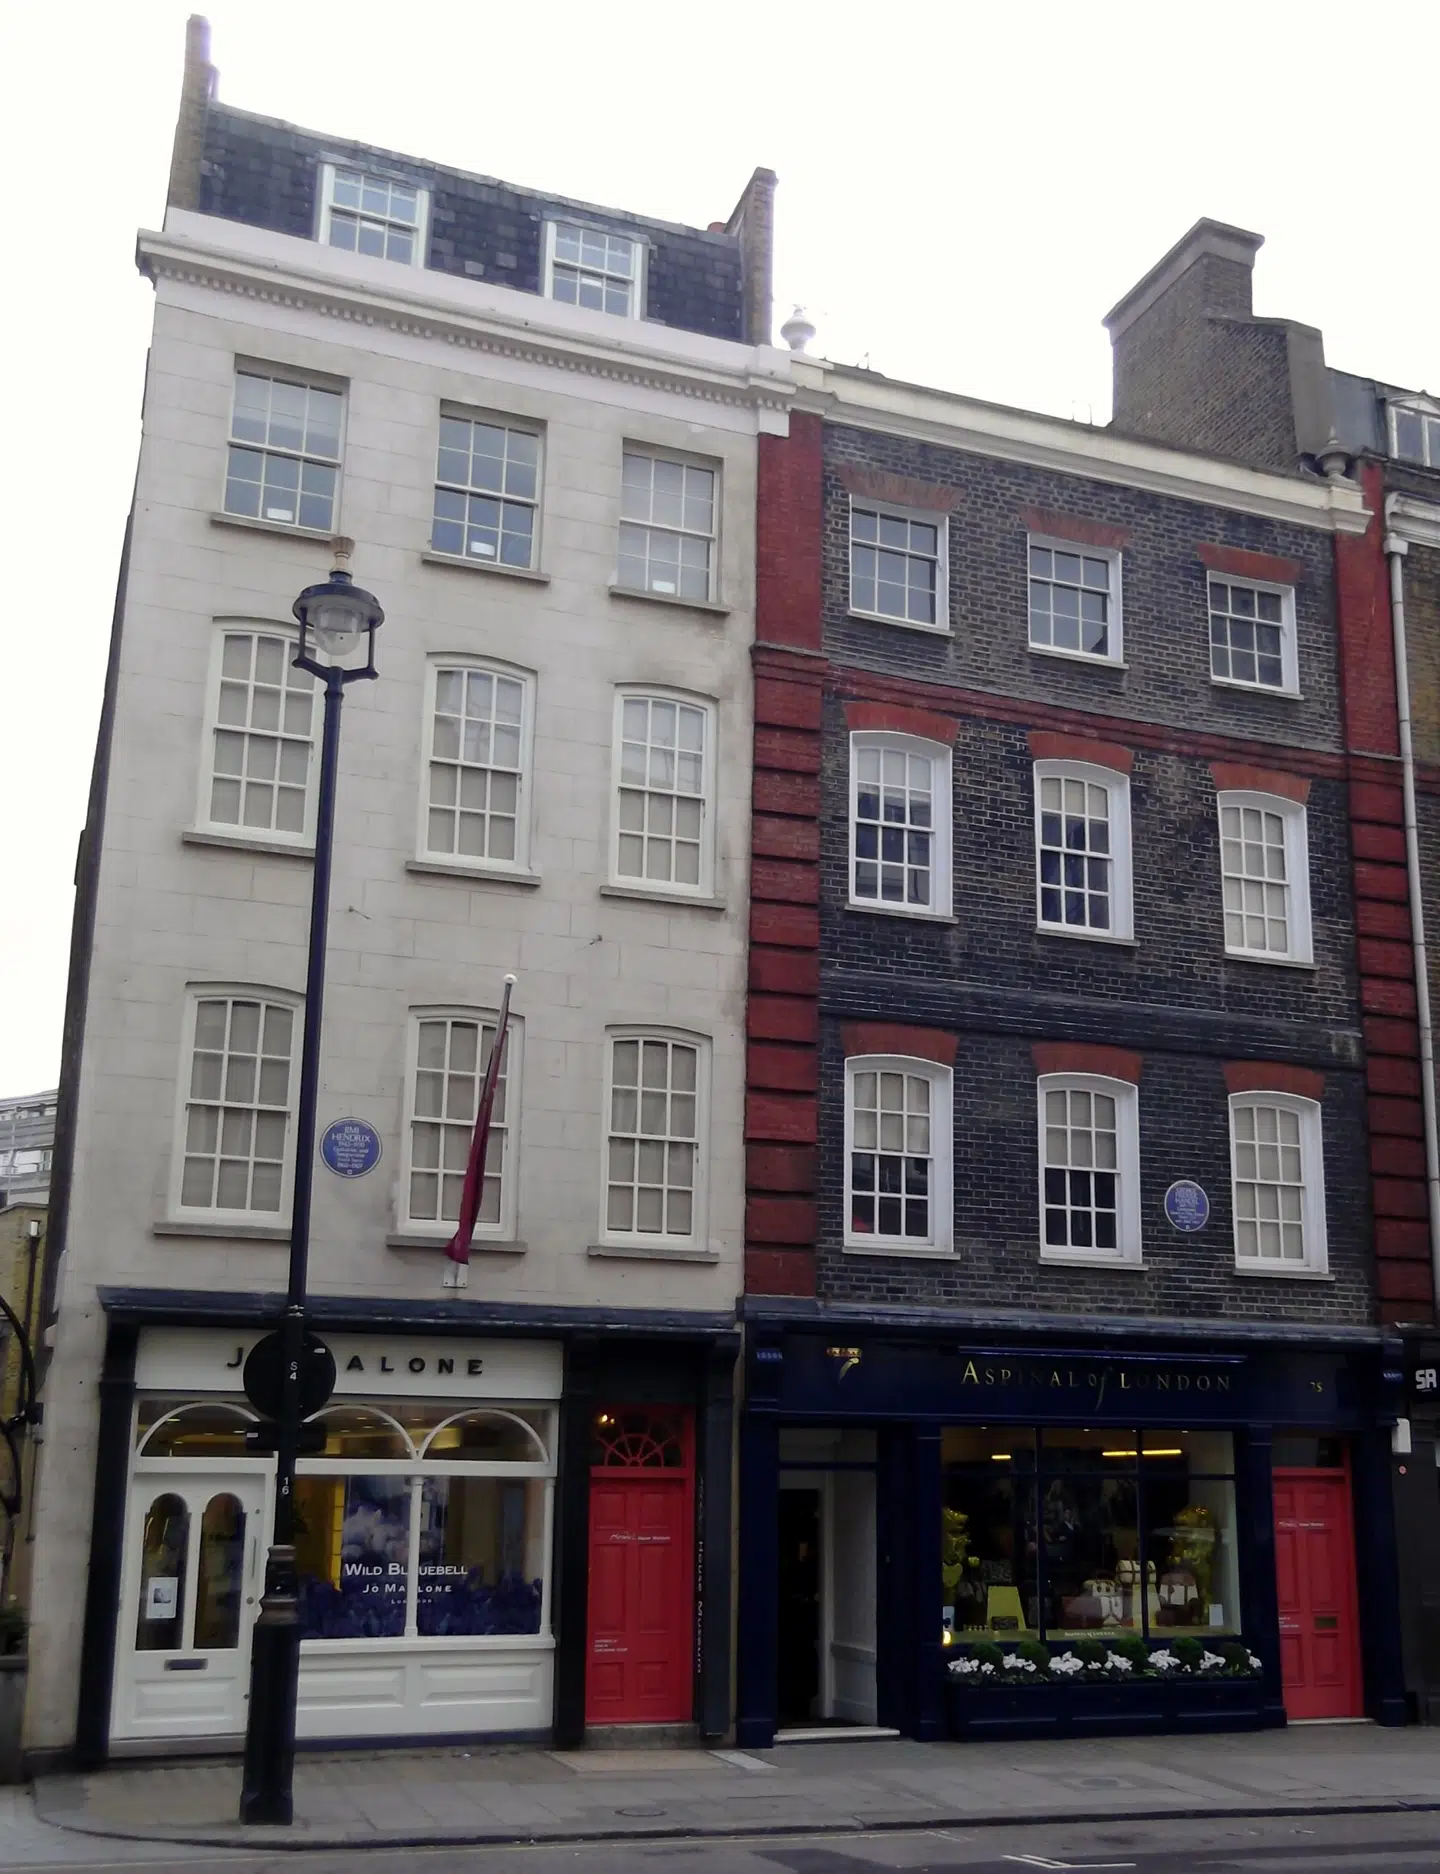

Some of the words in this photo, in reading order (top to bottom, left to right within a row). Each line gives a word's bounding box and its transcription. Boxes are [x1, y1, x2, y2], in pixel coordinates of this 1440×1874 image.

[331, 1132, 371, 1143] HENDRIX
[346, 1354, 484, 1376] ALONE
[960, 1359, 1080, 1389] ASPINAL
[1118, 1371, 1231, 1392] LONDON
[344, 1563, 383, 1576] WILD
[388, 1562, 469, 1576] BLUEBELL
[362, 1584, 379, 1593] JO
[384, 1583, 453, 1593] MALONE
